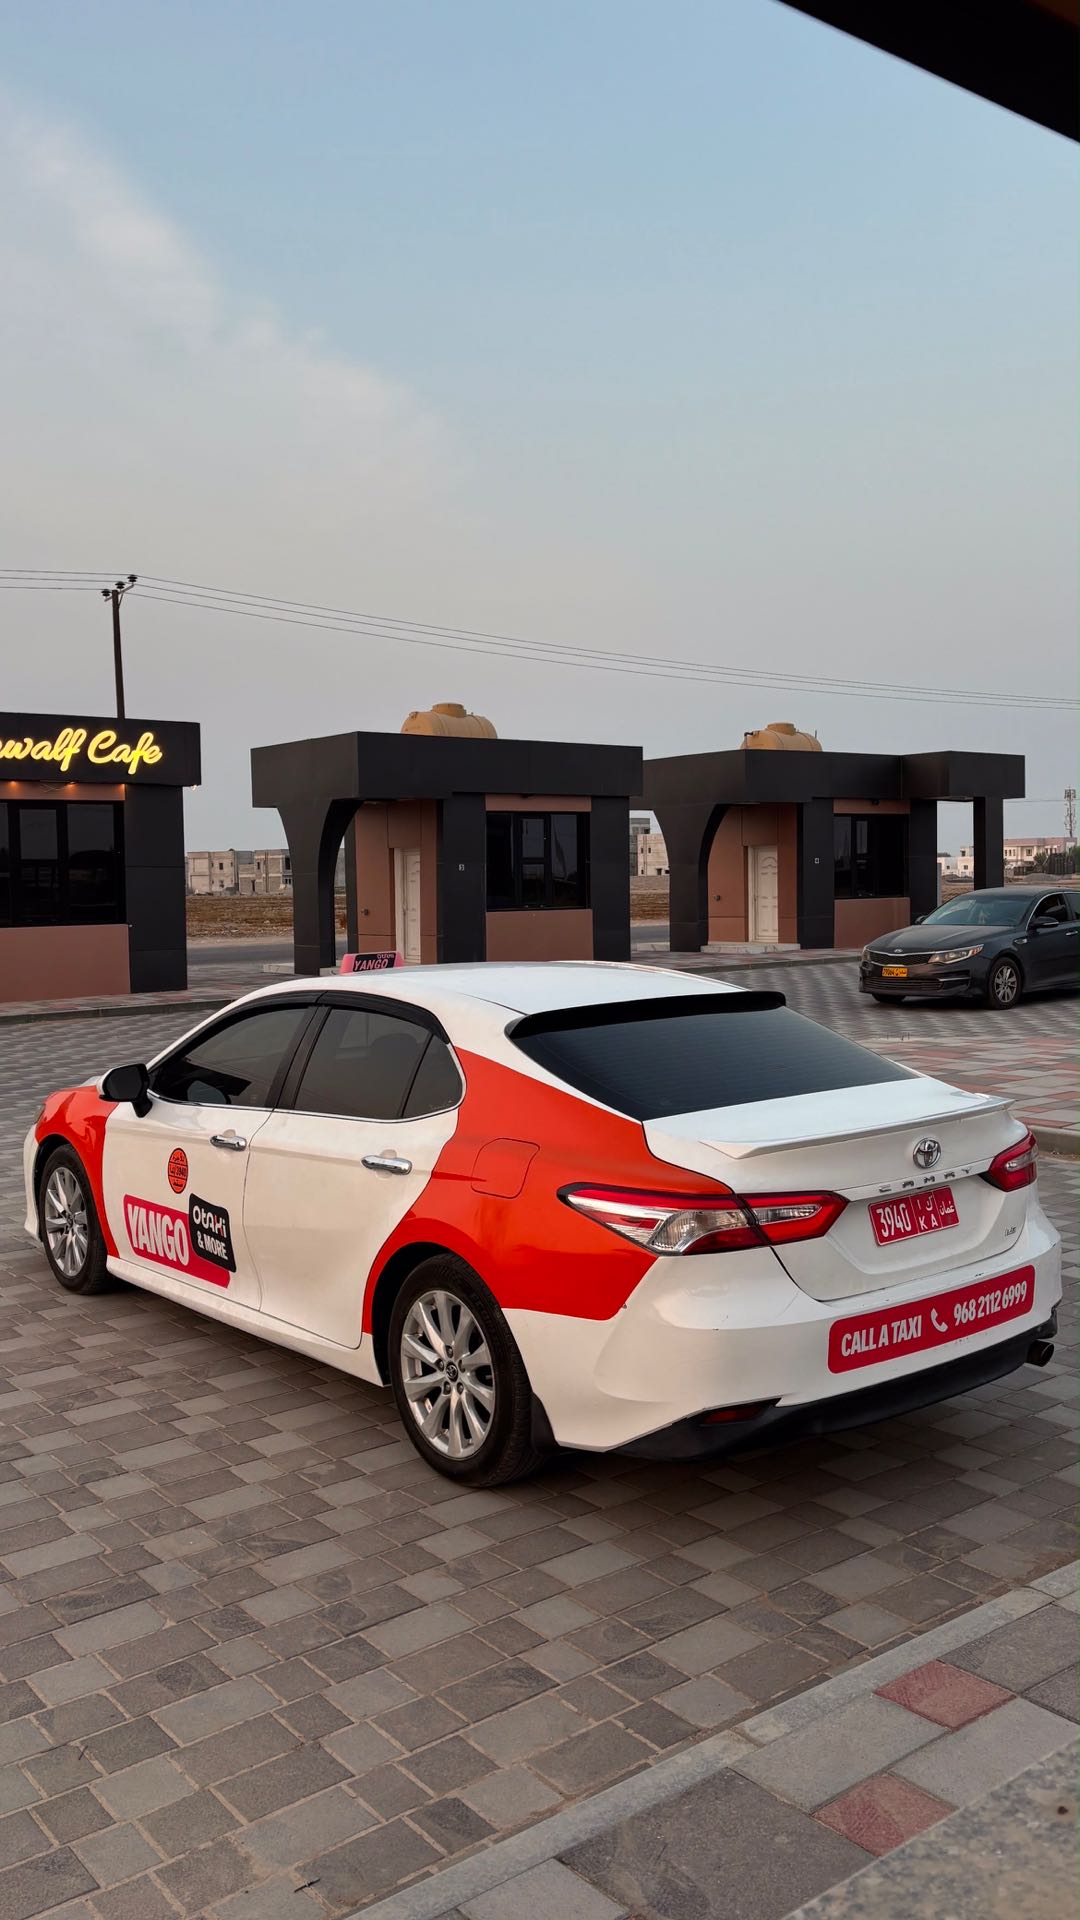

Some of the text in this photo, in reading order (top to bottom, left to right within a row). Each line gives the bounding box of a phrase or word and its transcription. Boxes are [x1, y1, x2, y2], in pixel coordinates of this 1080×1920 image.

[0, 728, 163, 775] walf Cafe
[354, 959, 389, 971] YANGO
[878, 1167, 972, 1193] CAMRY
[127, 1203, 190, 1266] YANGO
[876, 1203, 911, 1237] 3940
[197, 1230, 229, 1261] & MORE
[841, 1280, 1027, 1357] CALL A TAXI 968 2112 6999
